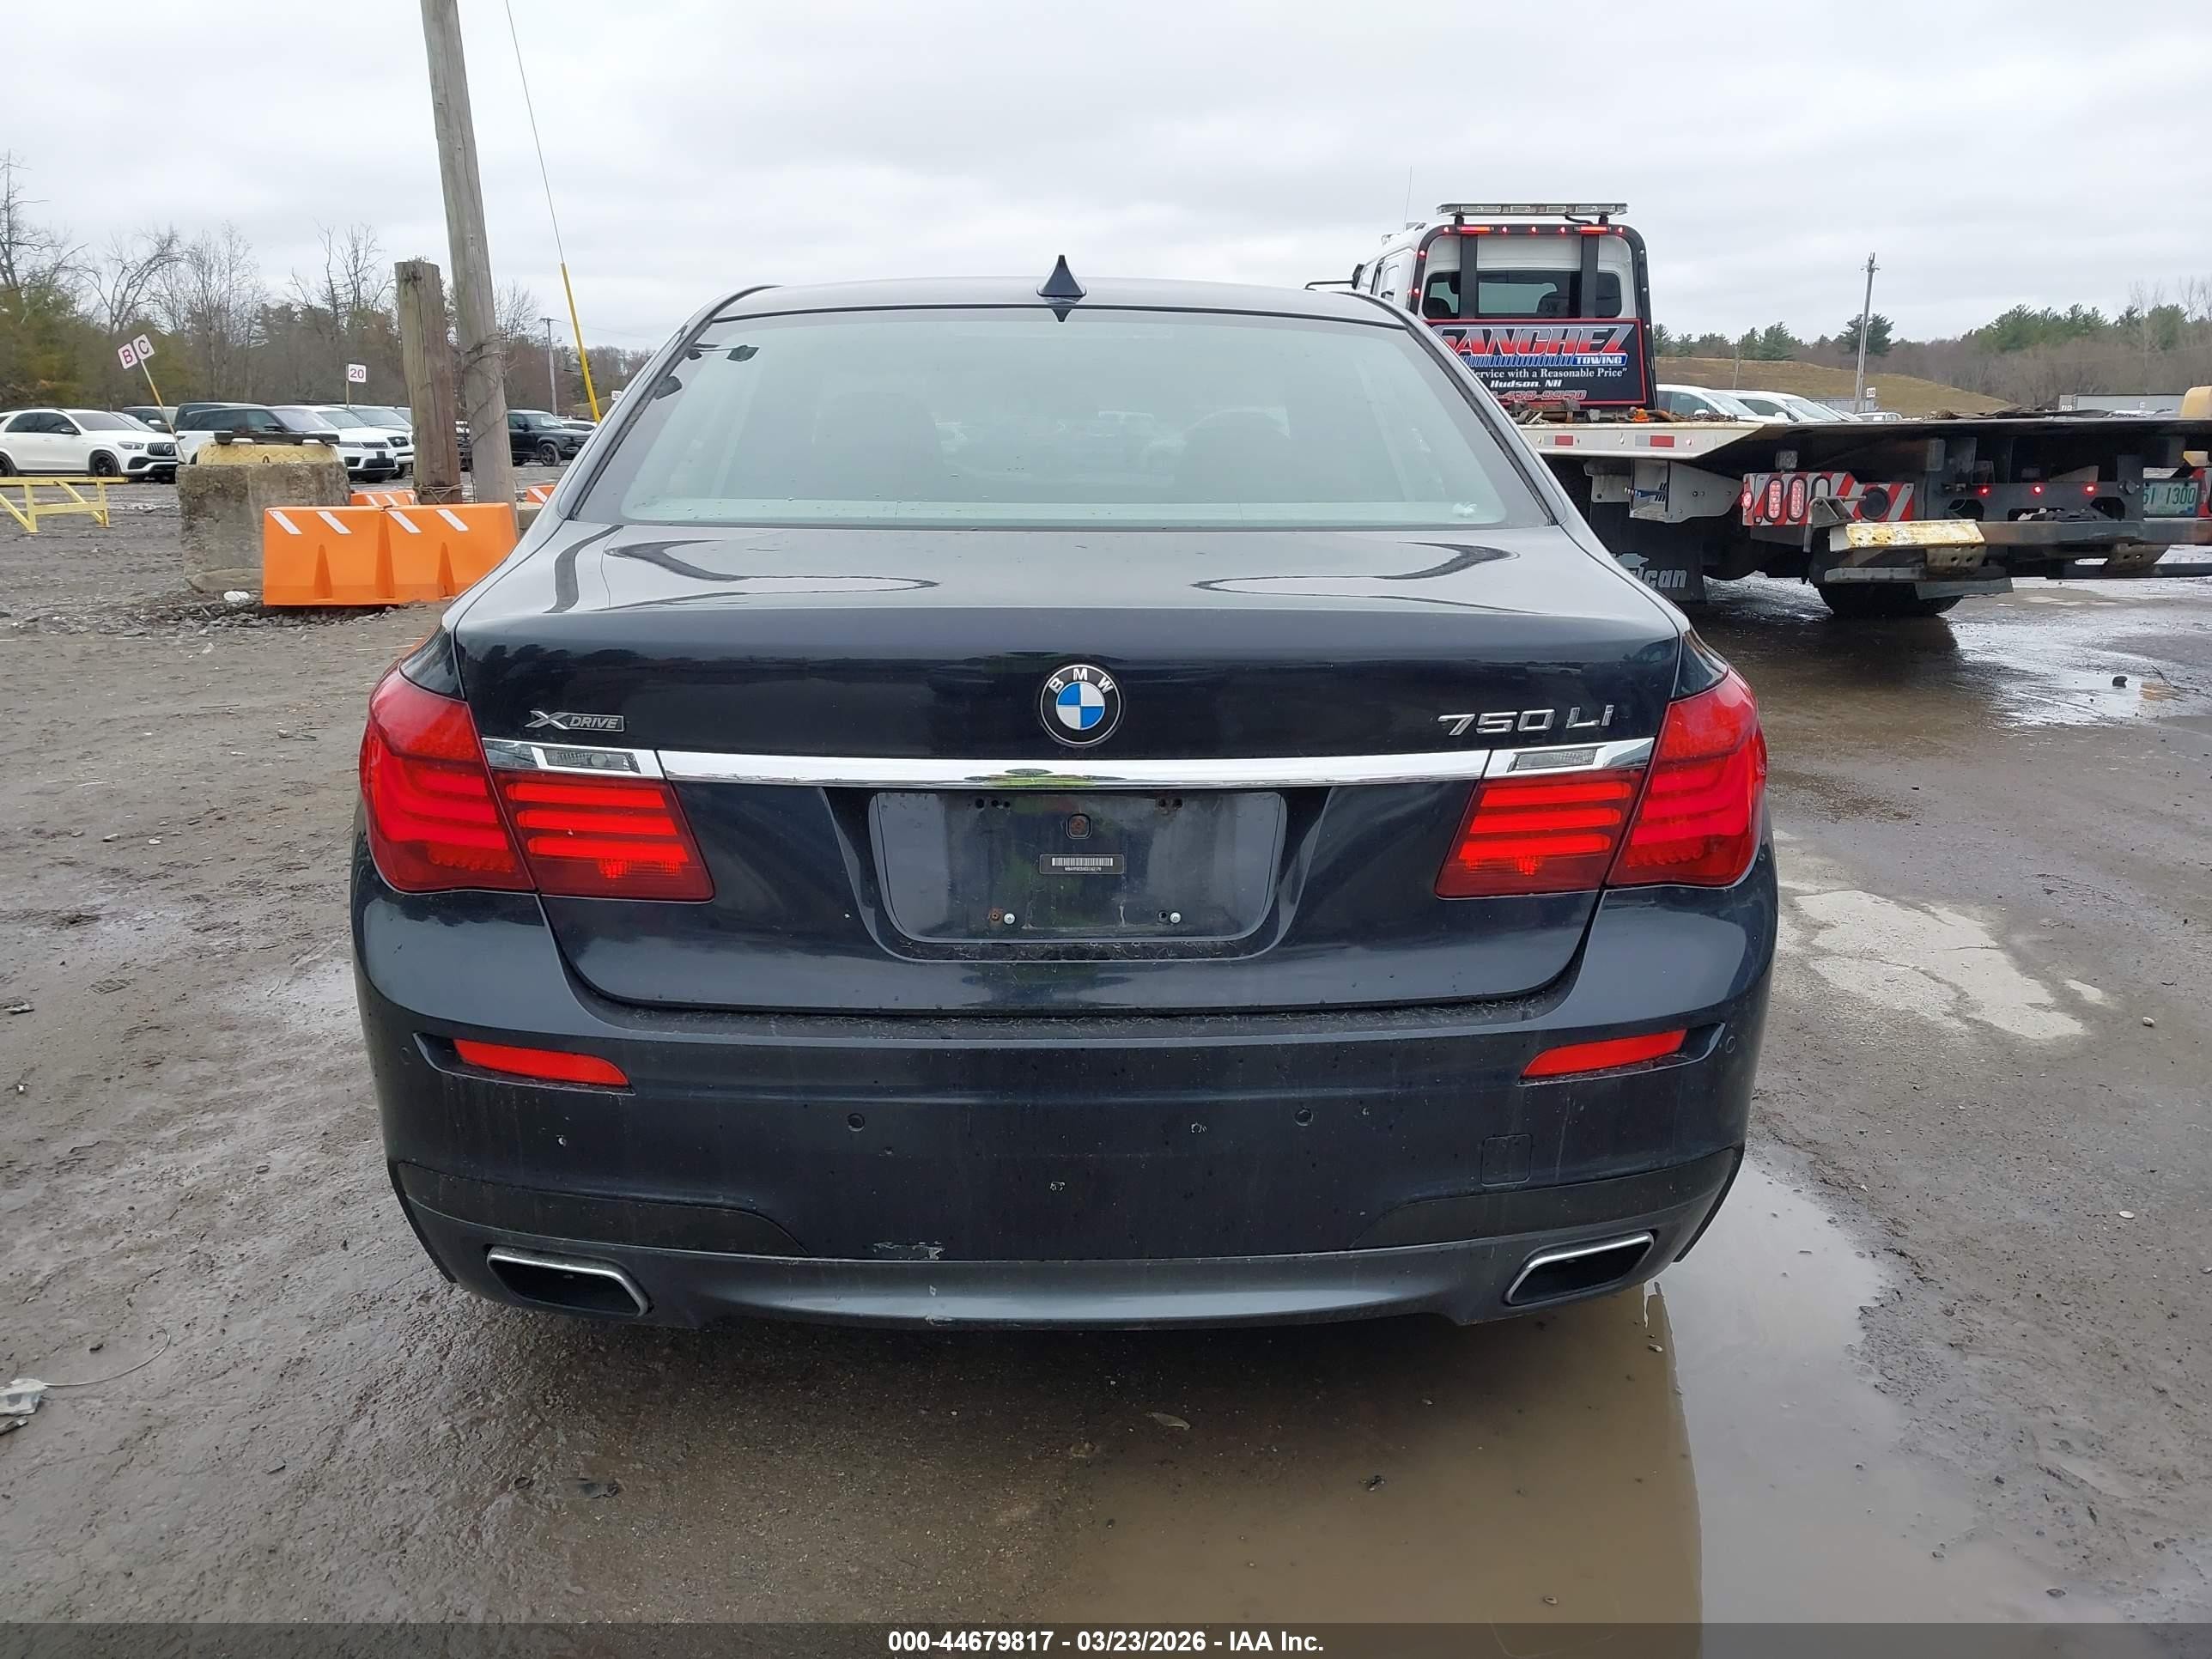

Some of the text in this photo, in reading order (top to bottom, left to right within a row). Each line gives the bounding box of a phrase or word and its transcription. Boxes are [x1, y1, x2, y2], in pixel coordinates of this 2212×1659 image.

[122, 340, 149, 364] B C
[1575, 356, 1623, 365] TOWING
[350, 368, 365, 380] 20
[1472, 369, 1505, 379] ervice
[1507, 368, 1529, 378] with
[1540, 368, 1595, 378] Reasonable
[2166, 487, 2196, 505] 1300
[1048, 667, 1114, 694] BMW
[1437, 704, 1615, 736] 750 Li
